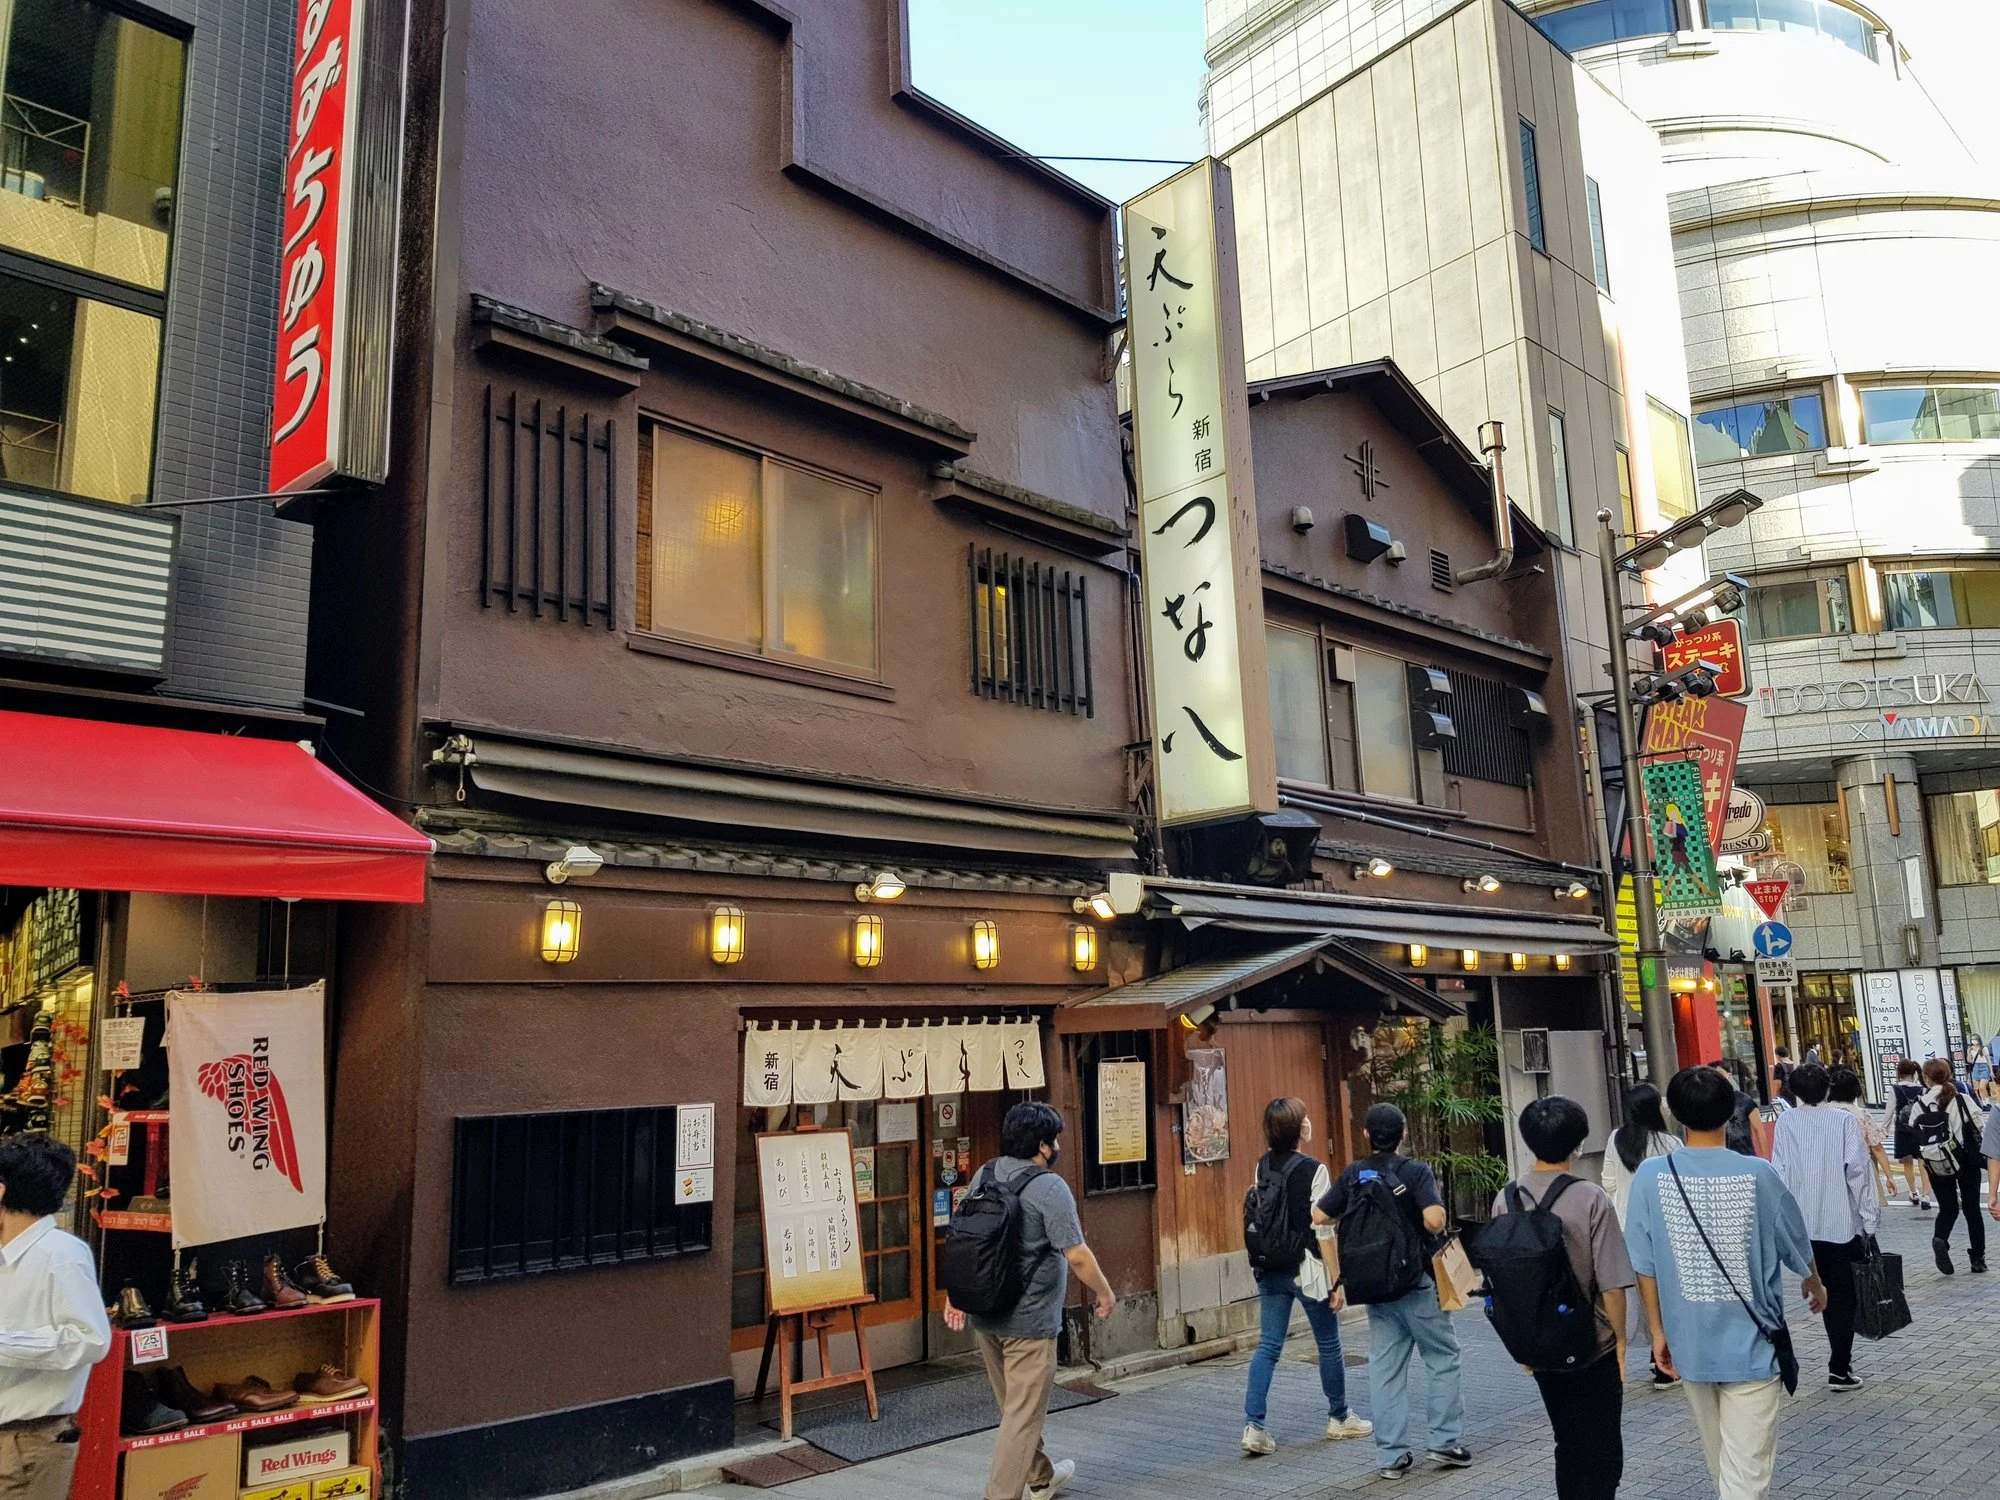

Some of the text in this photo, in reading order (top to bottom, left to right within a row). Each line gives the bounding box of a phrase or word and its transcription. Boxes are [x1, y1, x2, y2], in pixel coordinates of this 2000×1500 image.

[1146, 227, 1193, 420] 天ぷら
[1191, 414, 1213, 473] 新宿
[1152, 495, 1244, 762] つな八
[1675, 631, 1722, 648] がっつり系
[1667, 642, 1737, 669] ステーキ
[1836, 673, 1991, 710] OTSUKA
[1878, 712, 1998, 739] YAMADA
[1691, 767, 1704, 806] FUTABA
[1698, 812, 1711, 849] STREET
[1721, 837, 1758, 851] RESSO
[1753, 884, 1782, 895] 止まれ
[1758, 895, 1779, 903] STOP
[1758, 960, 1793, 970] 自転車を除く
[1759, 969, 1793, 977] 一方通行
[1870, 978, 1892, 989] IDC
[1913, 974, 1925, 992] IDC
[1916, 993, 1931, 1035] OTSUKA
[1873, 1025, 1902, 1033] コラボで
[1013, 1039, 1031, 1079] つな八
[1877, 1046, 1904, 1054] 暮らしを
[763, 1051, 780, 1091] 新宿
[228, 1063, 245, 1152] SHOES
[252, 1036, 271, 1171] RED WING
[692, 1117, 701, 1152] お弁当
[775, 1158, 787, 1198] あわび
[1707, 1173, 1756, 1184] VISIONS.
[1707, 1182, 1756, 1192] VISIONS.
[1707, 1190, 1755, 1201] VISIONS.
[1708, 1199, 1755, 1209] VISIONS.
[1661, 1205, 1707, 1217] DYNAIC
[1663, 1214, 1707, 1226] DYNAMC
[783, 1228, 793, 1264] 若あゆ
[131, 1399, 375, 1449] SALE SALE SALE SALE SALE SALE SALE SALE SALE
[260, 1453, 289, 1473] Red
[292, 1448, 337, 1467] Wings
